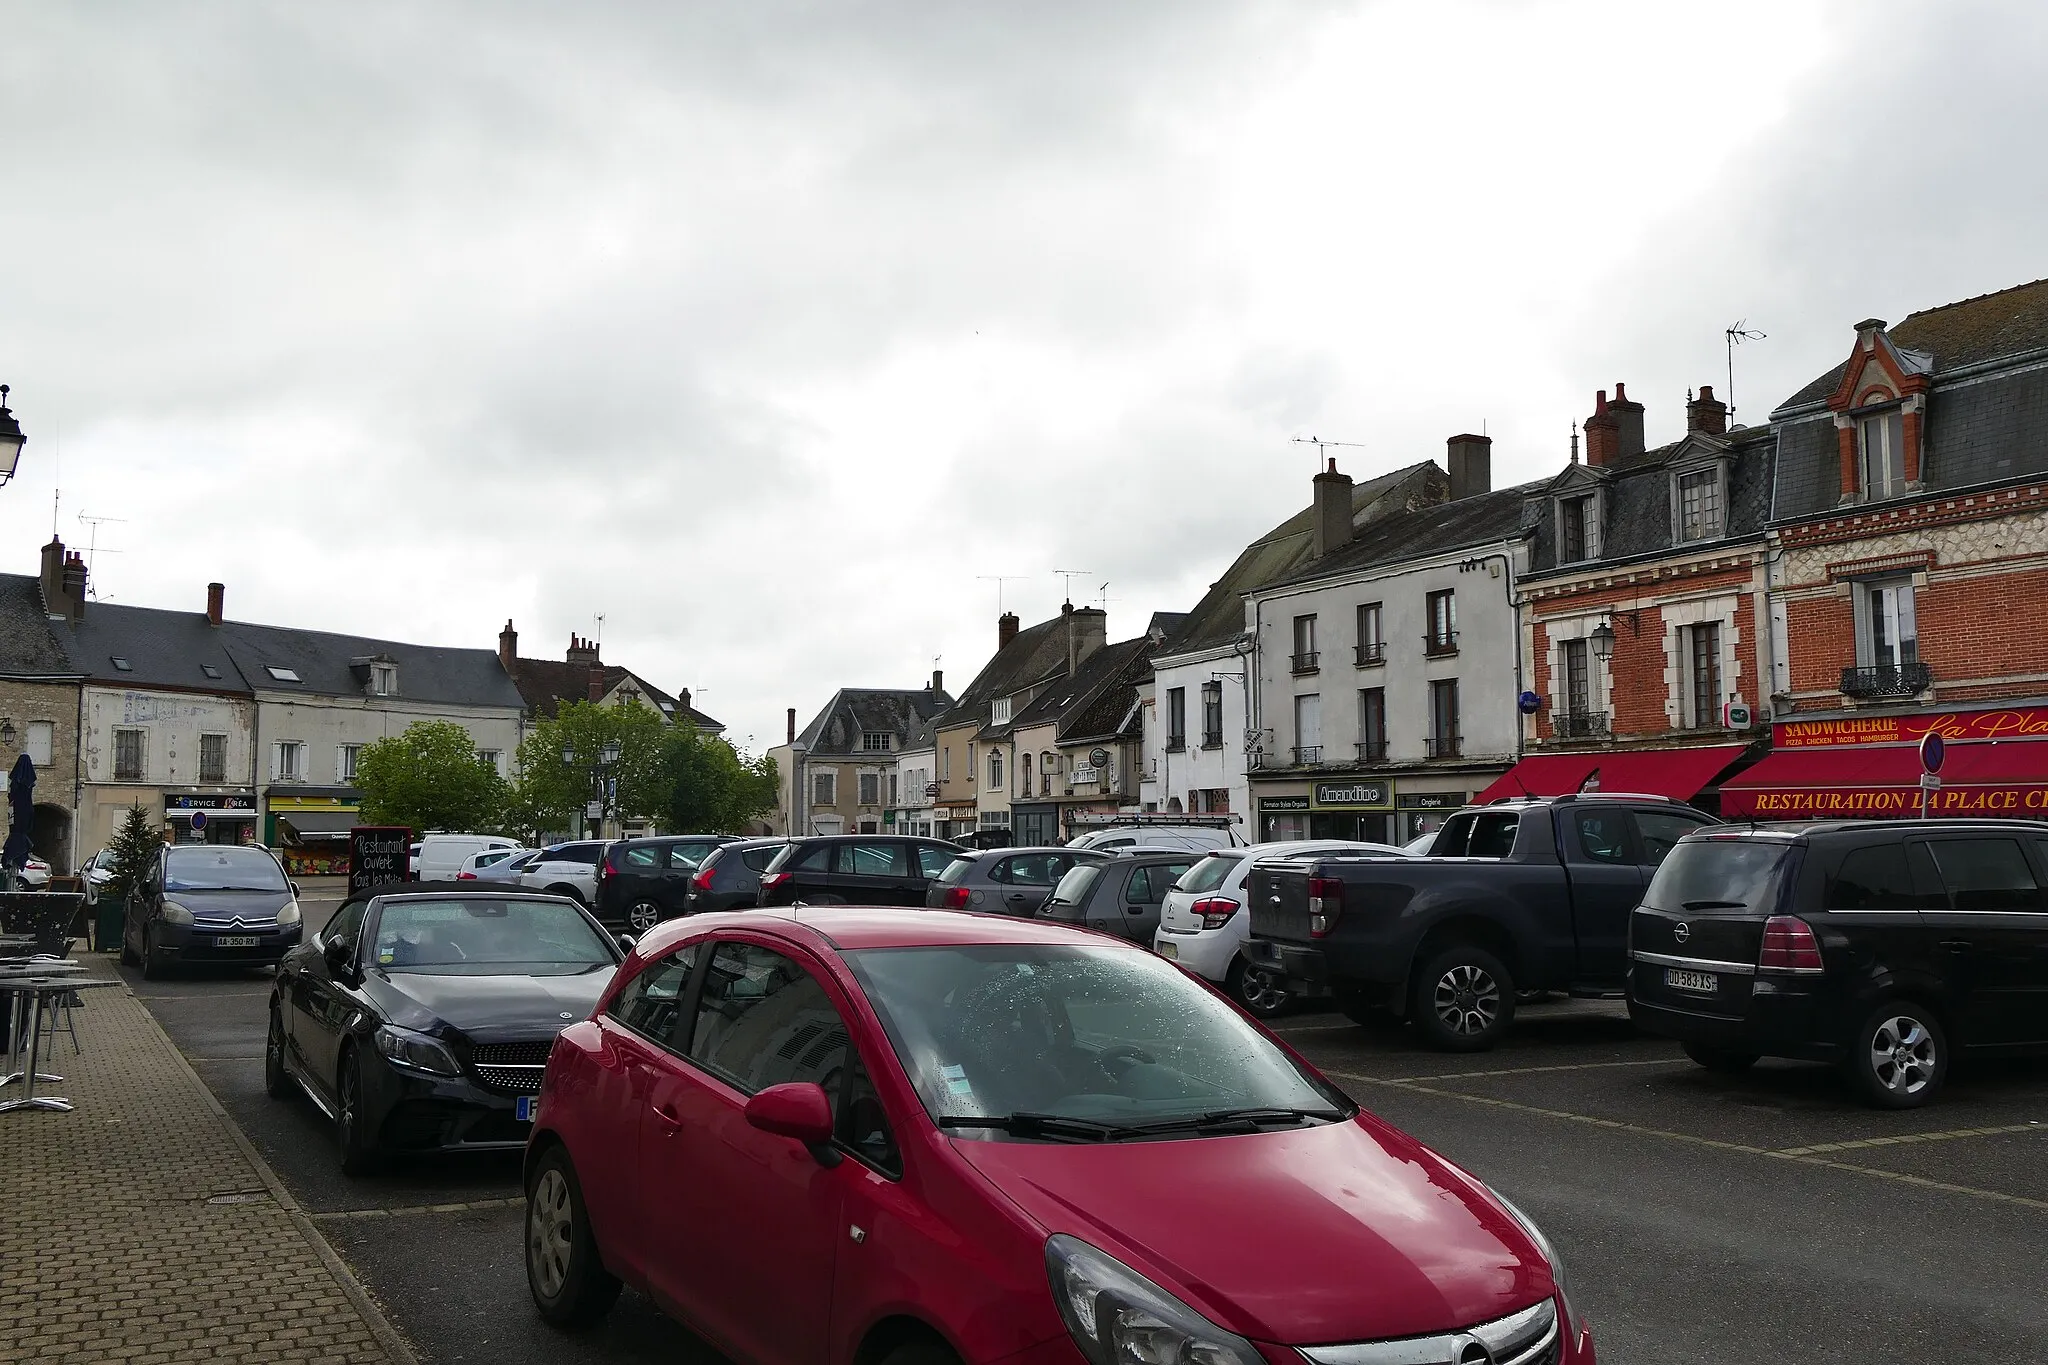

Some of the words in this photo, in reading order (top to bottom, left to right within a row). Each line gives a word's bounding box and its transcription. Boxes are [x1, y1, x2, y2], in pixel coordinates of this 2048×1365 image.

[1785, 718, 1899, 737] SANDWICHERIE
[1907, 714, 1967, 740] La
[1806, 737, 1832, 745] CHICKEN
[1860, 733, 1899, 742] HAMBURGER
[181, 797, 216, 808] SERVICE
[1319, 786, 1379, 802] Amandine
[1421, 798, 1441, 807] Onglerie
[1755, 792, 1906, 809] RESTAURATION
[1911, 792, 1939, 809] LA
[1943, 791, 2018, 809] PLACE
[355, 834, 406, 856] Restaurant
[1669, 968, 1712, 989] DD-583-XS
